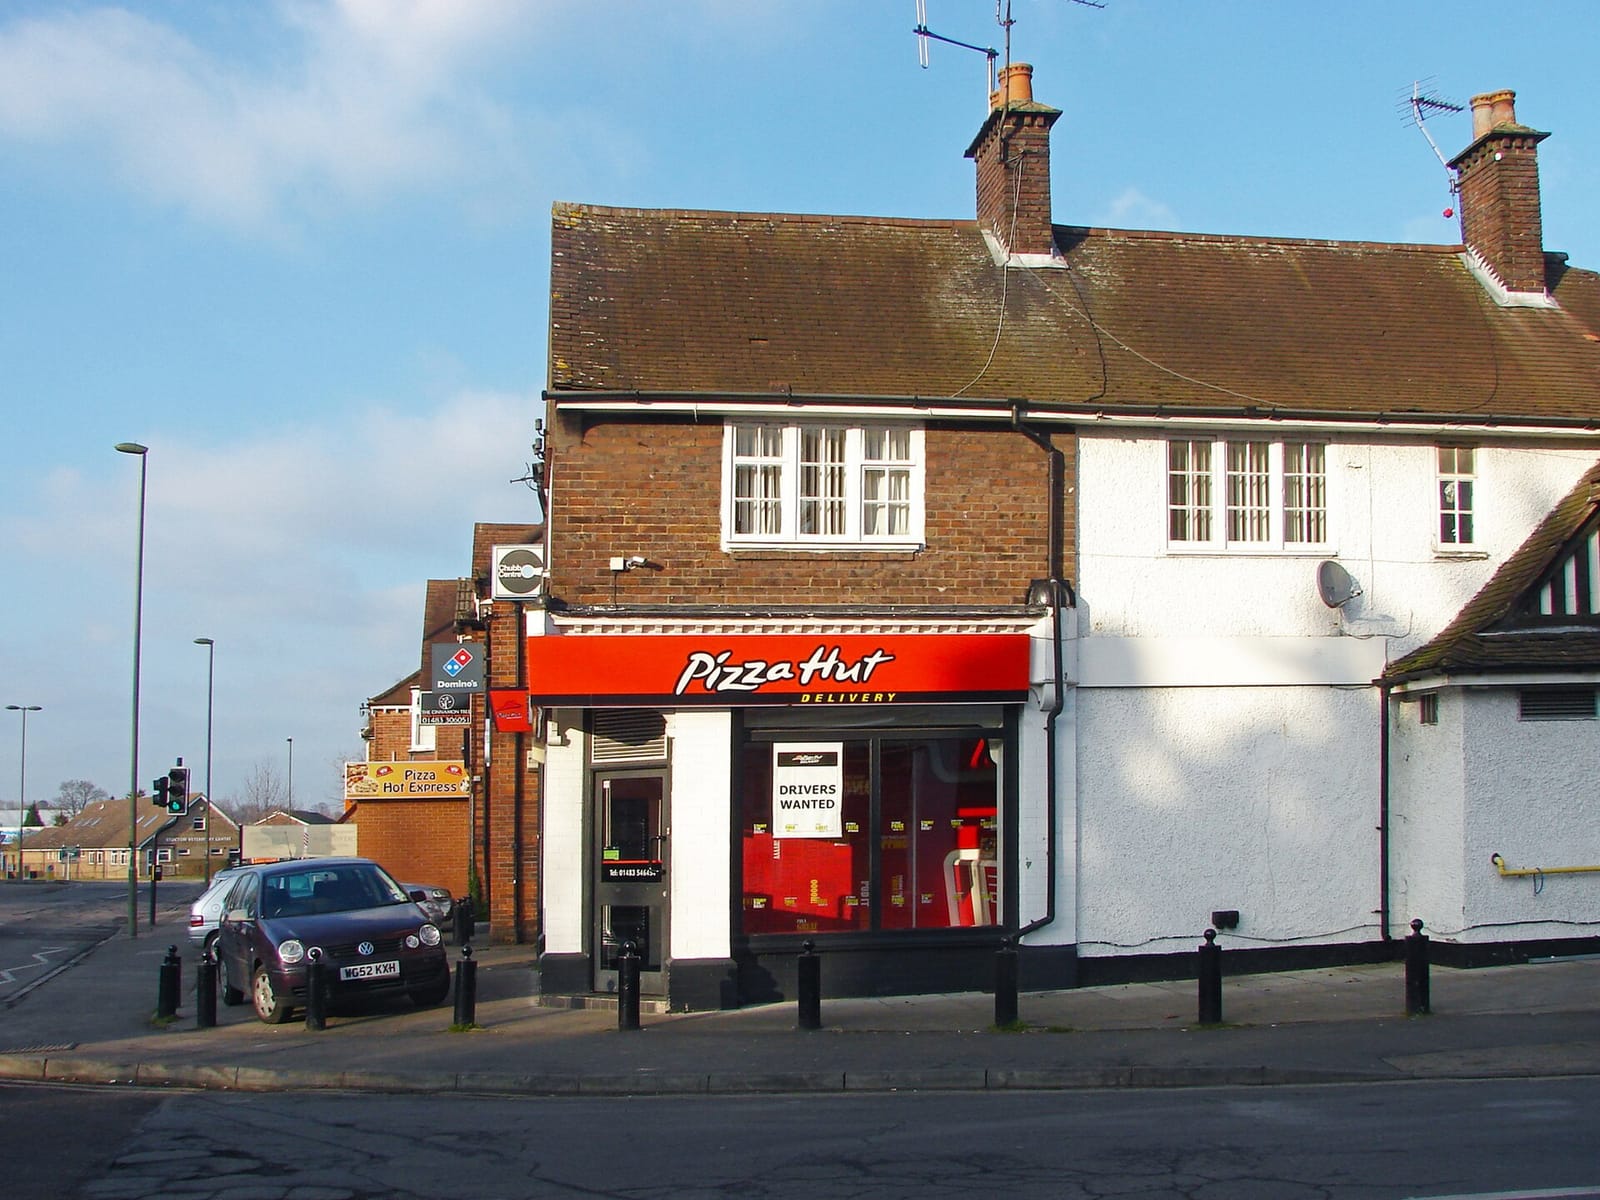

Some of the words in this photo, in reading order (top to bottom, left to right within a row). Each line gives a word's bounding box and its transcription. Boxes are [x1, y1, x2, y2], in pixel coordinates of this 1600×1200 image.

[498, 564, 522, 572] Chubb
[674, 650, 794, 696] Pizza
[797, 645, 895, 686] Hut
[437, 680, 478, 689] Domino's
[801, 692, 897, 704] DELIVERY
[404, 769, 436, 781] Pizza
[383, 782, 405, 793] Hot
[409, 782, 457, 793] Express
[779, 784, 837, 795] DRIVERS
[780, 799, 835, 809] WANTED
[618, 869, 636, 877] 01483
[344, 966, 373, 979] WG52
[375, 963, 396, 975] KXH
